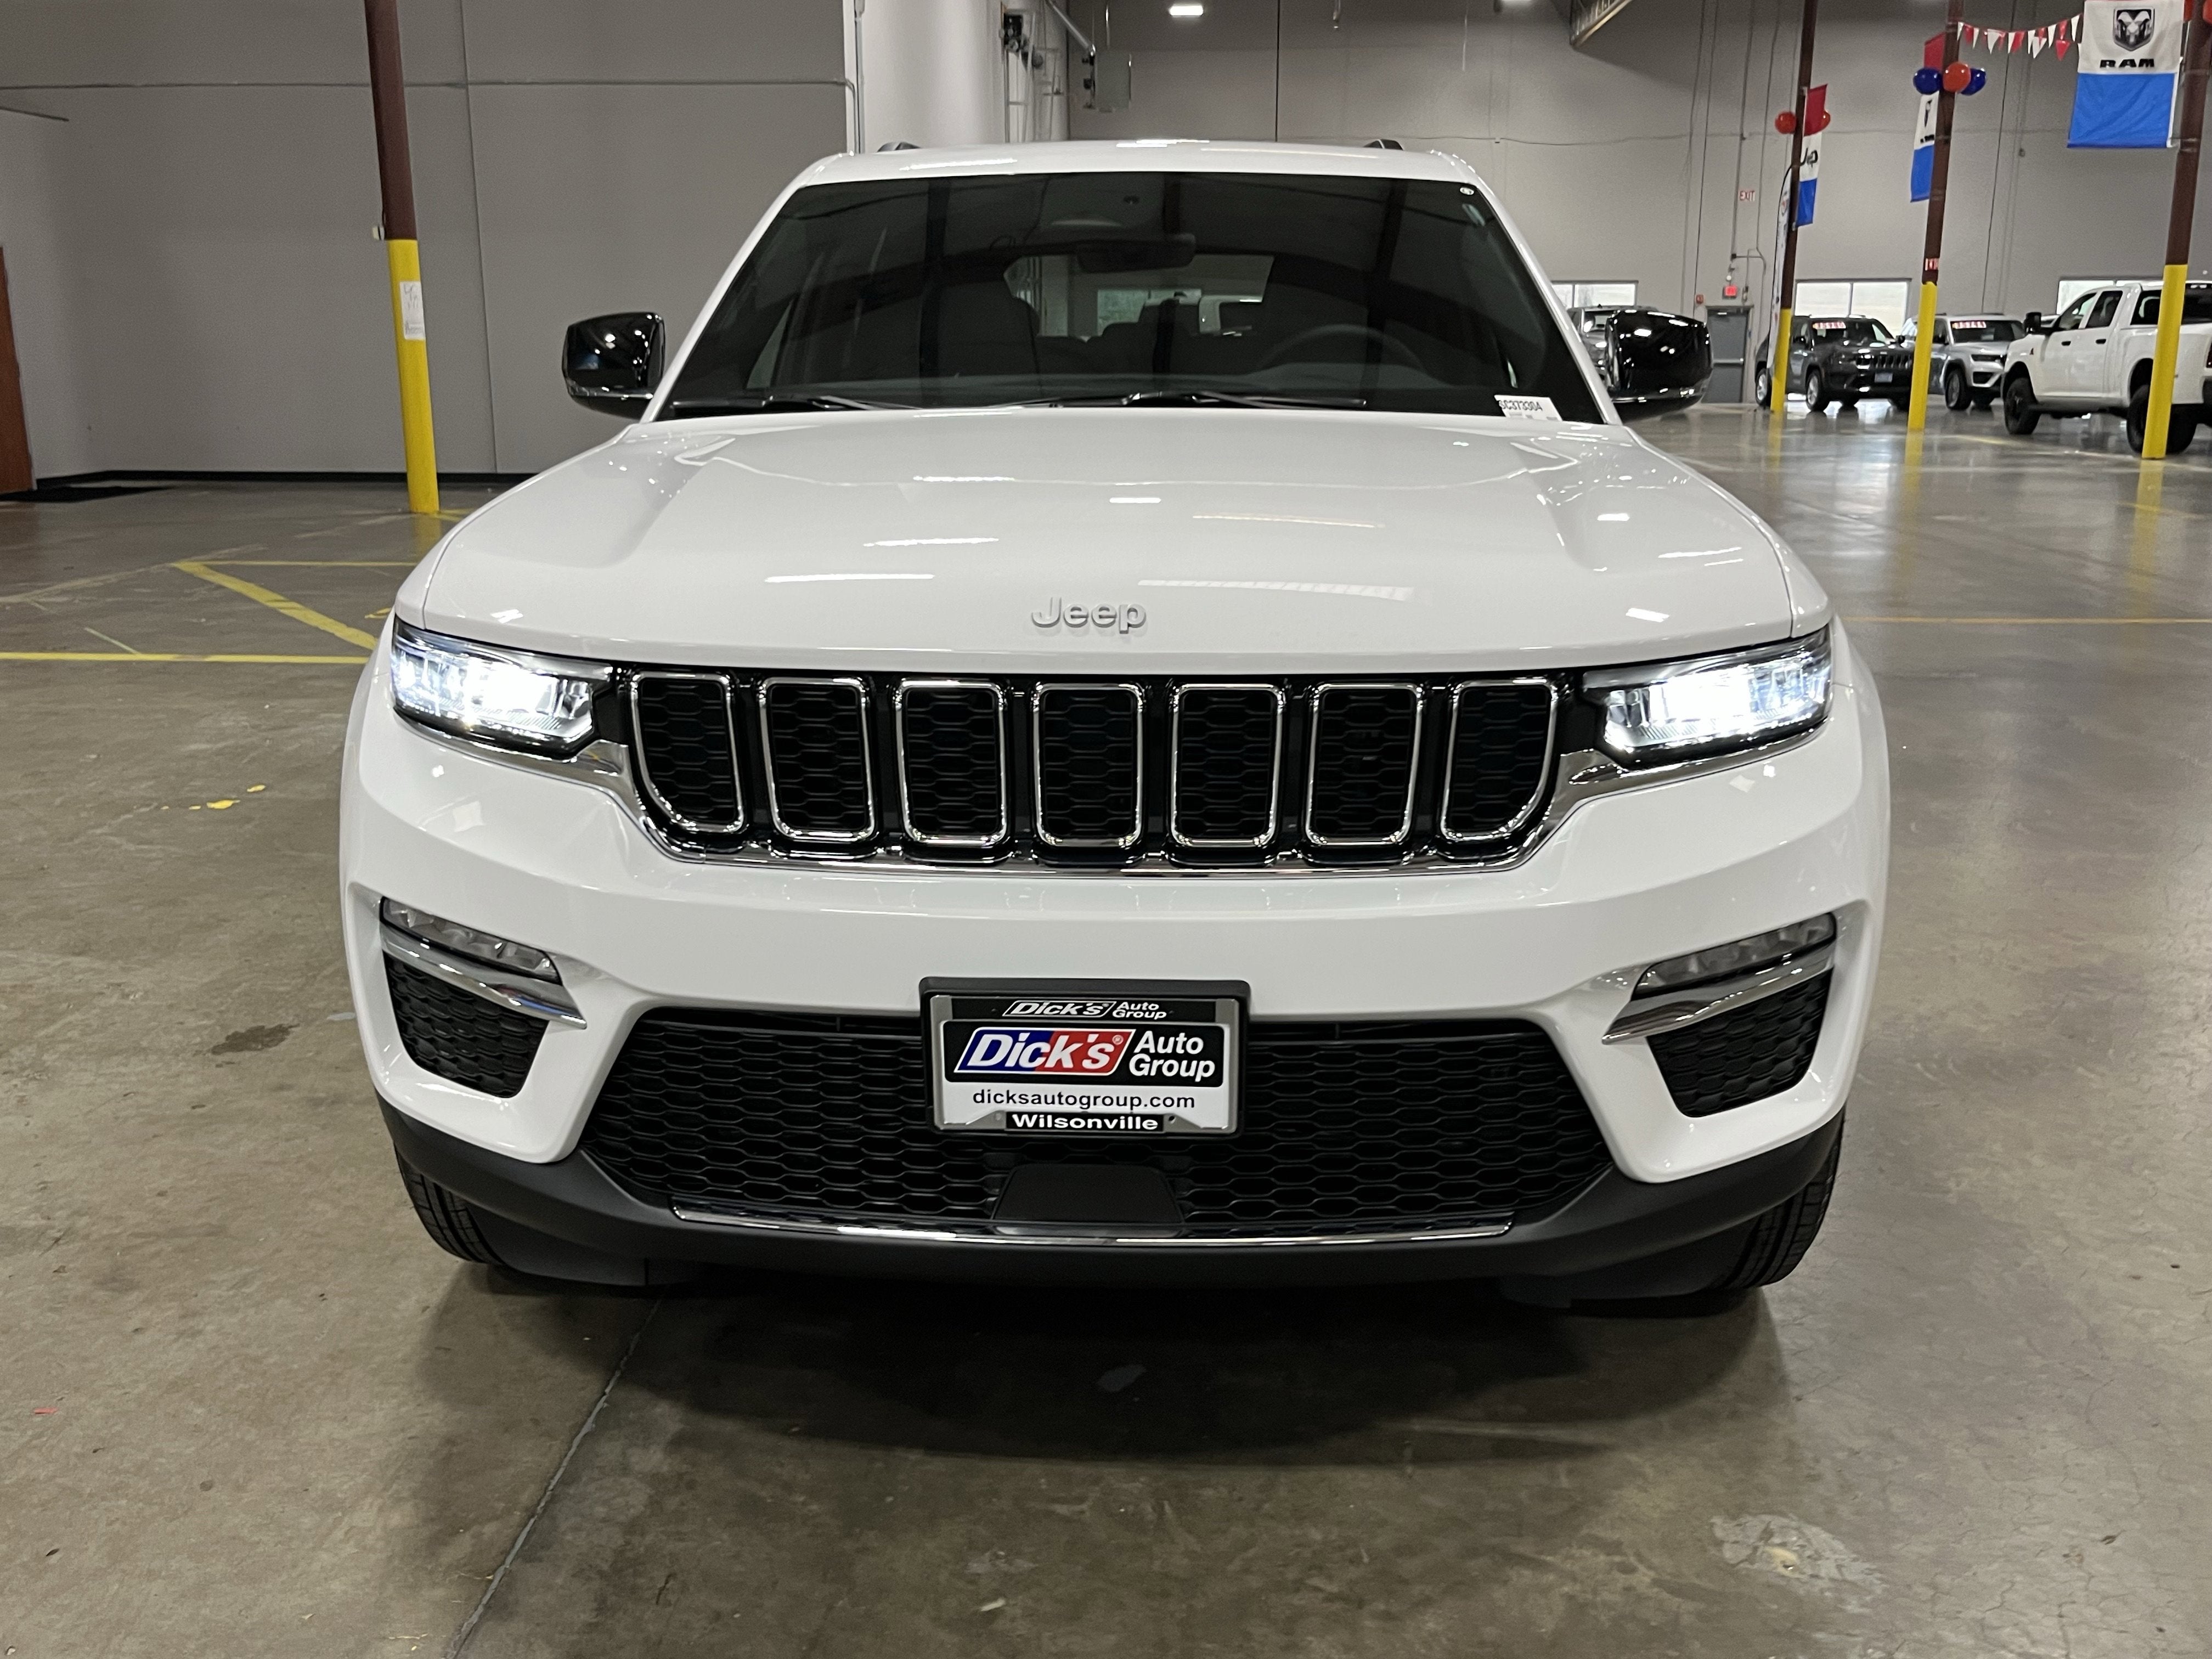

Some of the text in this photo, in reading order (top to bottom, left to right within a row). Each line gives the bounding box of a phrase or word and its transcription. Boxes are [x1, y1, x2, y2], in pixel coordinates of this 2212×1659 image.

[2100, 58, 2154, 68] RAM
[1031, 596, 1147, 634] Jeep
[1112, 1009, 1167, 1020] Group
[1117, 1001, 1159, 1011] Auto
[1133, 1030, 1204, 1054] Auto
[1129, 1053, 1215, 1082] Group
[973, 1089, 1195, 1110] dicksautogroup.com
[1012, 1113, 1159, 1130] Wilsonville
